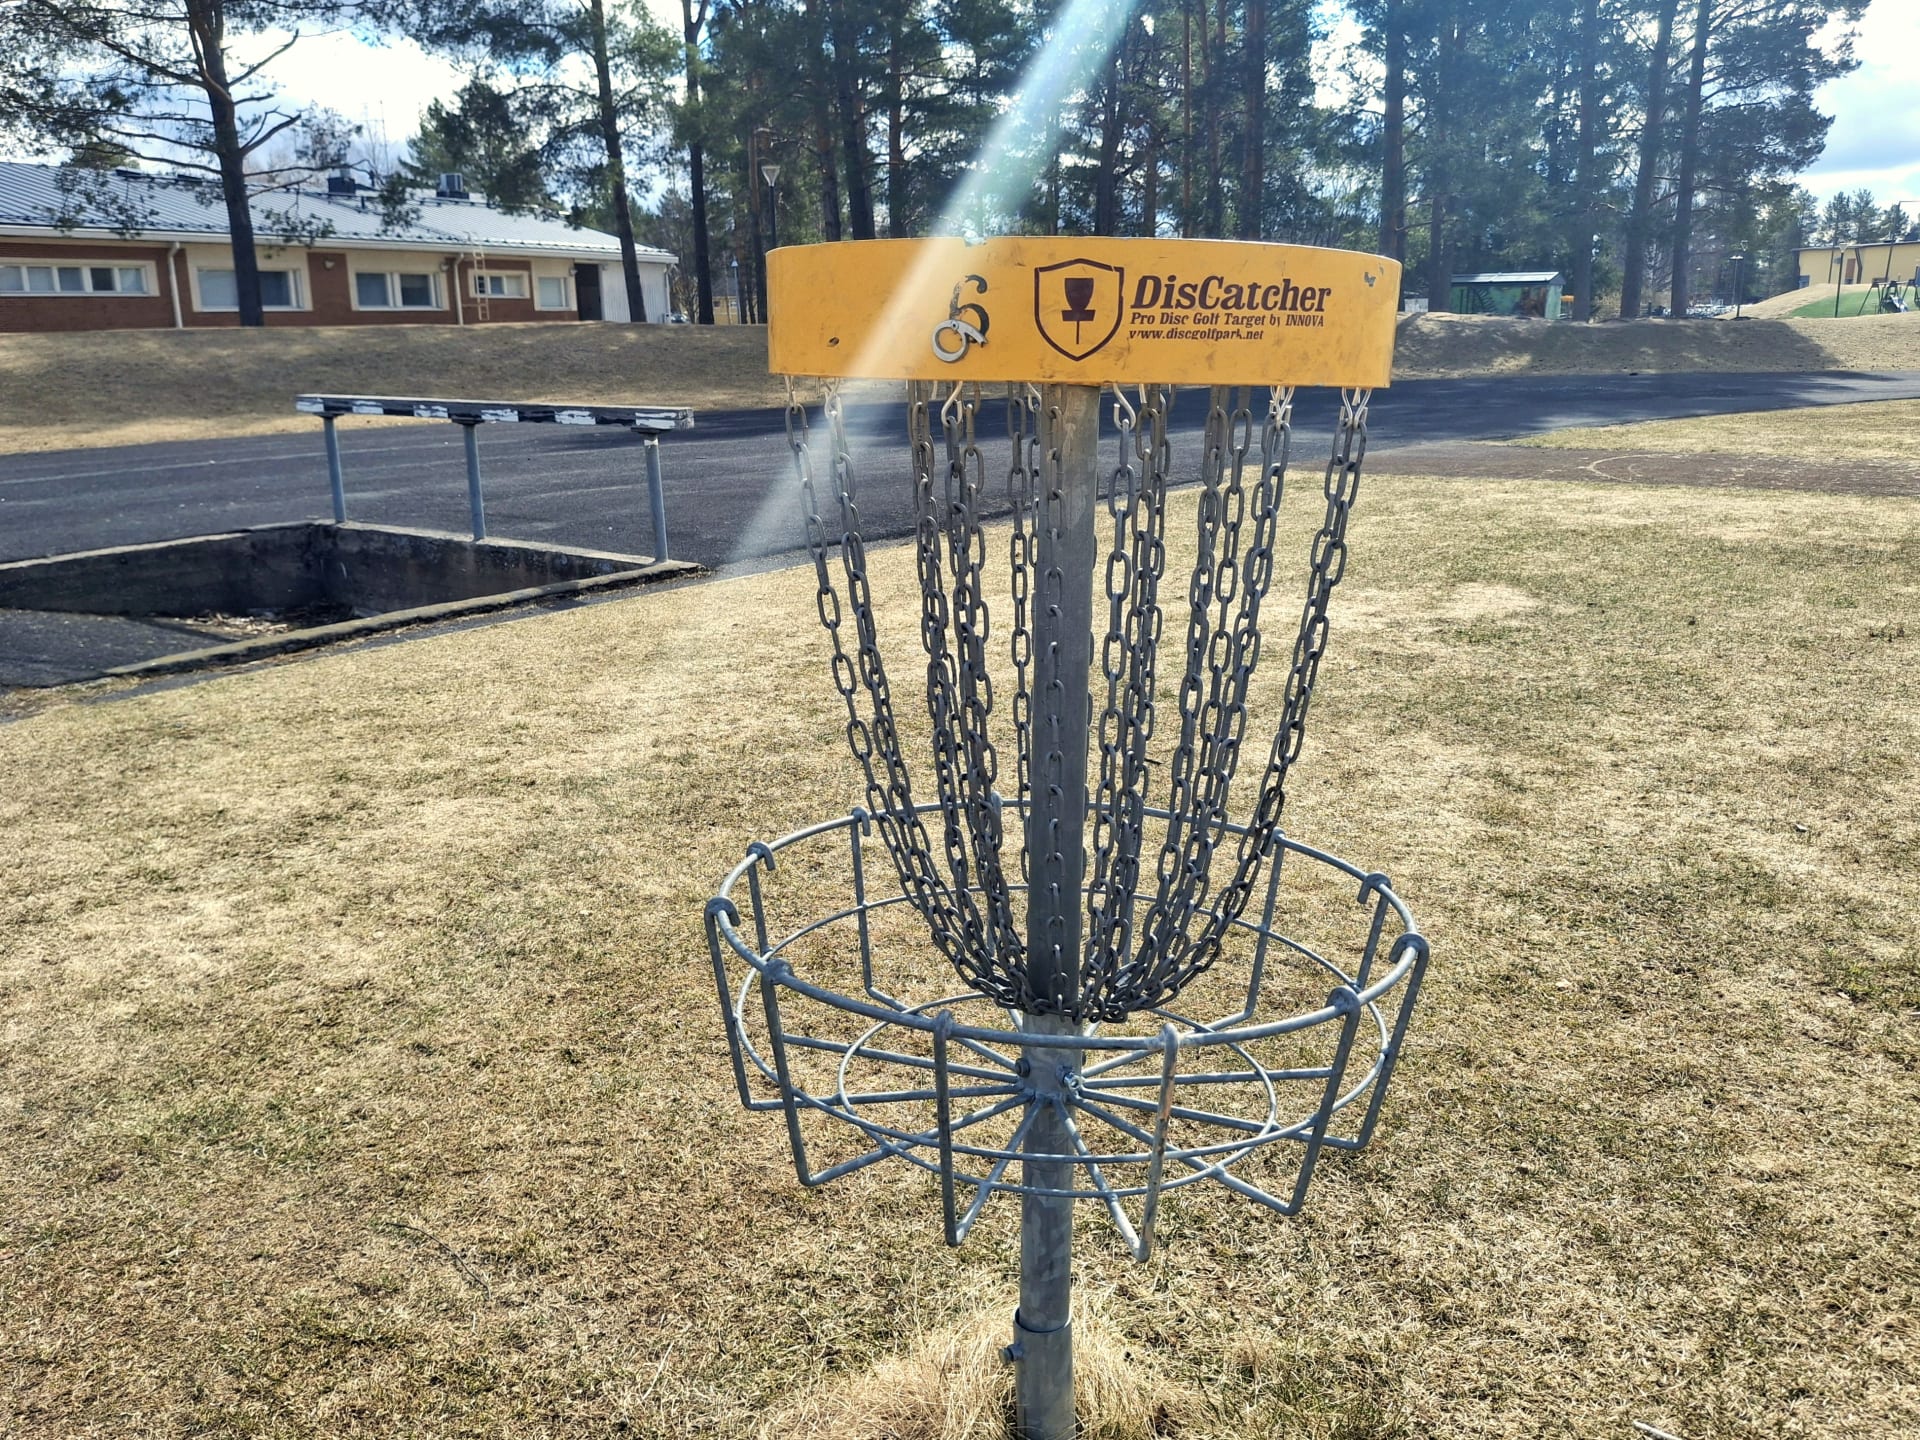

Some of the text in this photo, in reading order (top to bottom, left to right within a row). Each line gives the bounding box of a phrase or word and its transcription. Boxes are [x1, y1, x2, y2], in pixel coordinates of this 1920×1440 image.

[949, 274, 990, 345] 6
[1130, 275, 1331, 311] DisCatcher
[1130, 312, 1155, 325] Pro
[1159, 312, 1190, 326] Disc
[1193, 312, 1219, 326] Golf
[1223, 313, 1266, 328] Target
[1285, 315, 1325, 327] INNOVA
